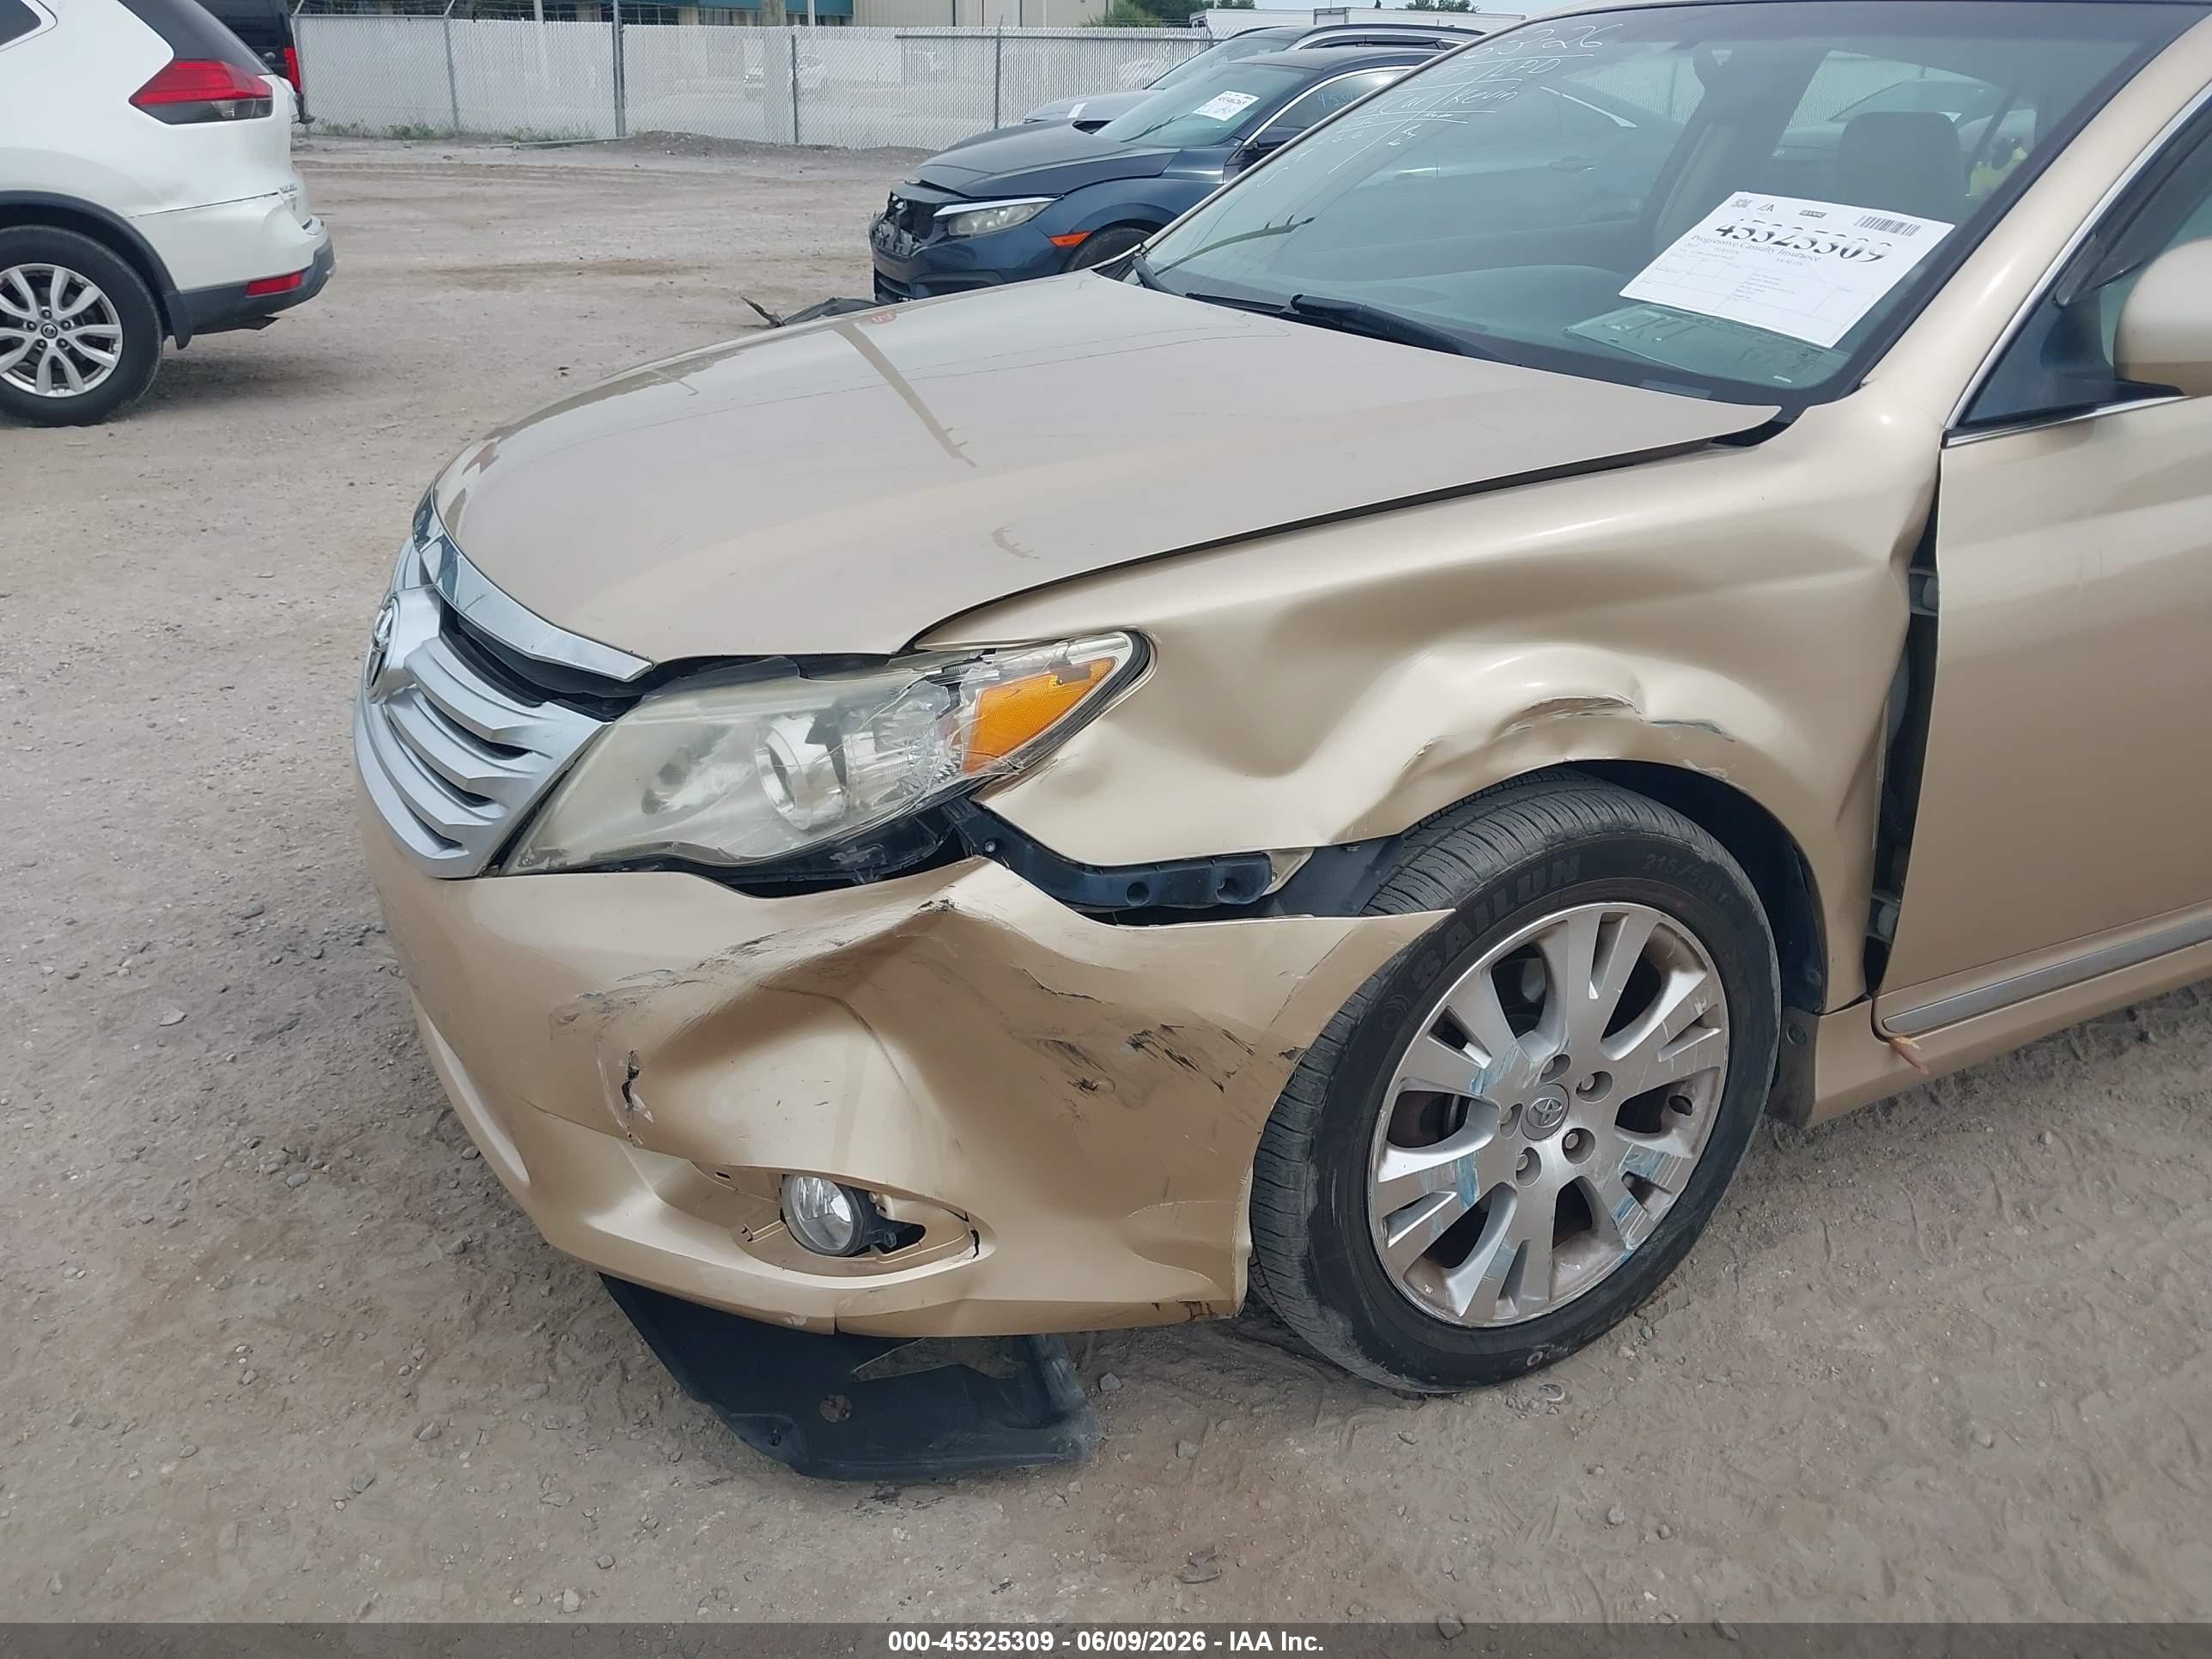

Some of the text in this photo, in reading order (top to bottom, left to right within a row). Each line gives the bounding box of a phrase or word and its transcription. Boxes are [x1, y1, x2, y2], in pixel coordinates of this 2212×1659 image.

[1444, 86, 1518, 105] Kevin
[1691, 234, 1741, 248] Progressive
[1740, 241, 1775, 256] Casualty
[1778, 247, 1821, 262] Insurance
[1715, 218, 1893, 263] 45325309
[1412, 854, 1581, 991] SAILUN
